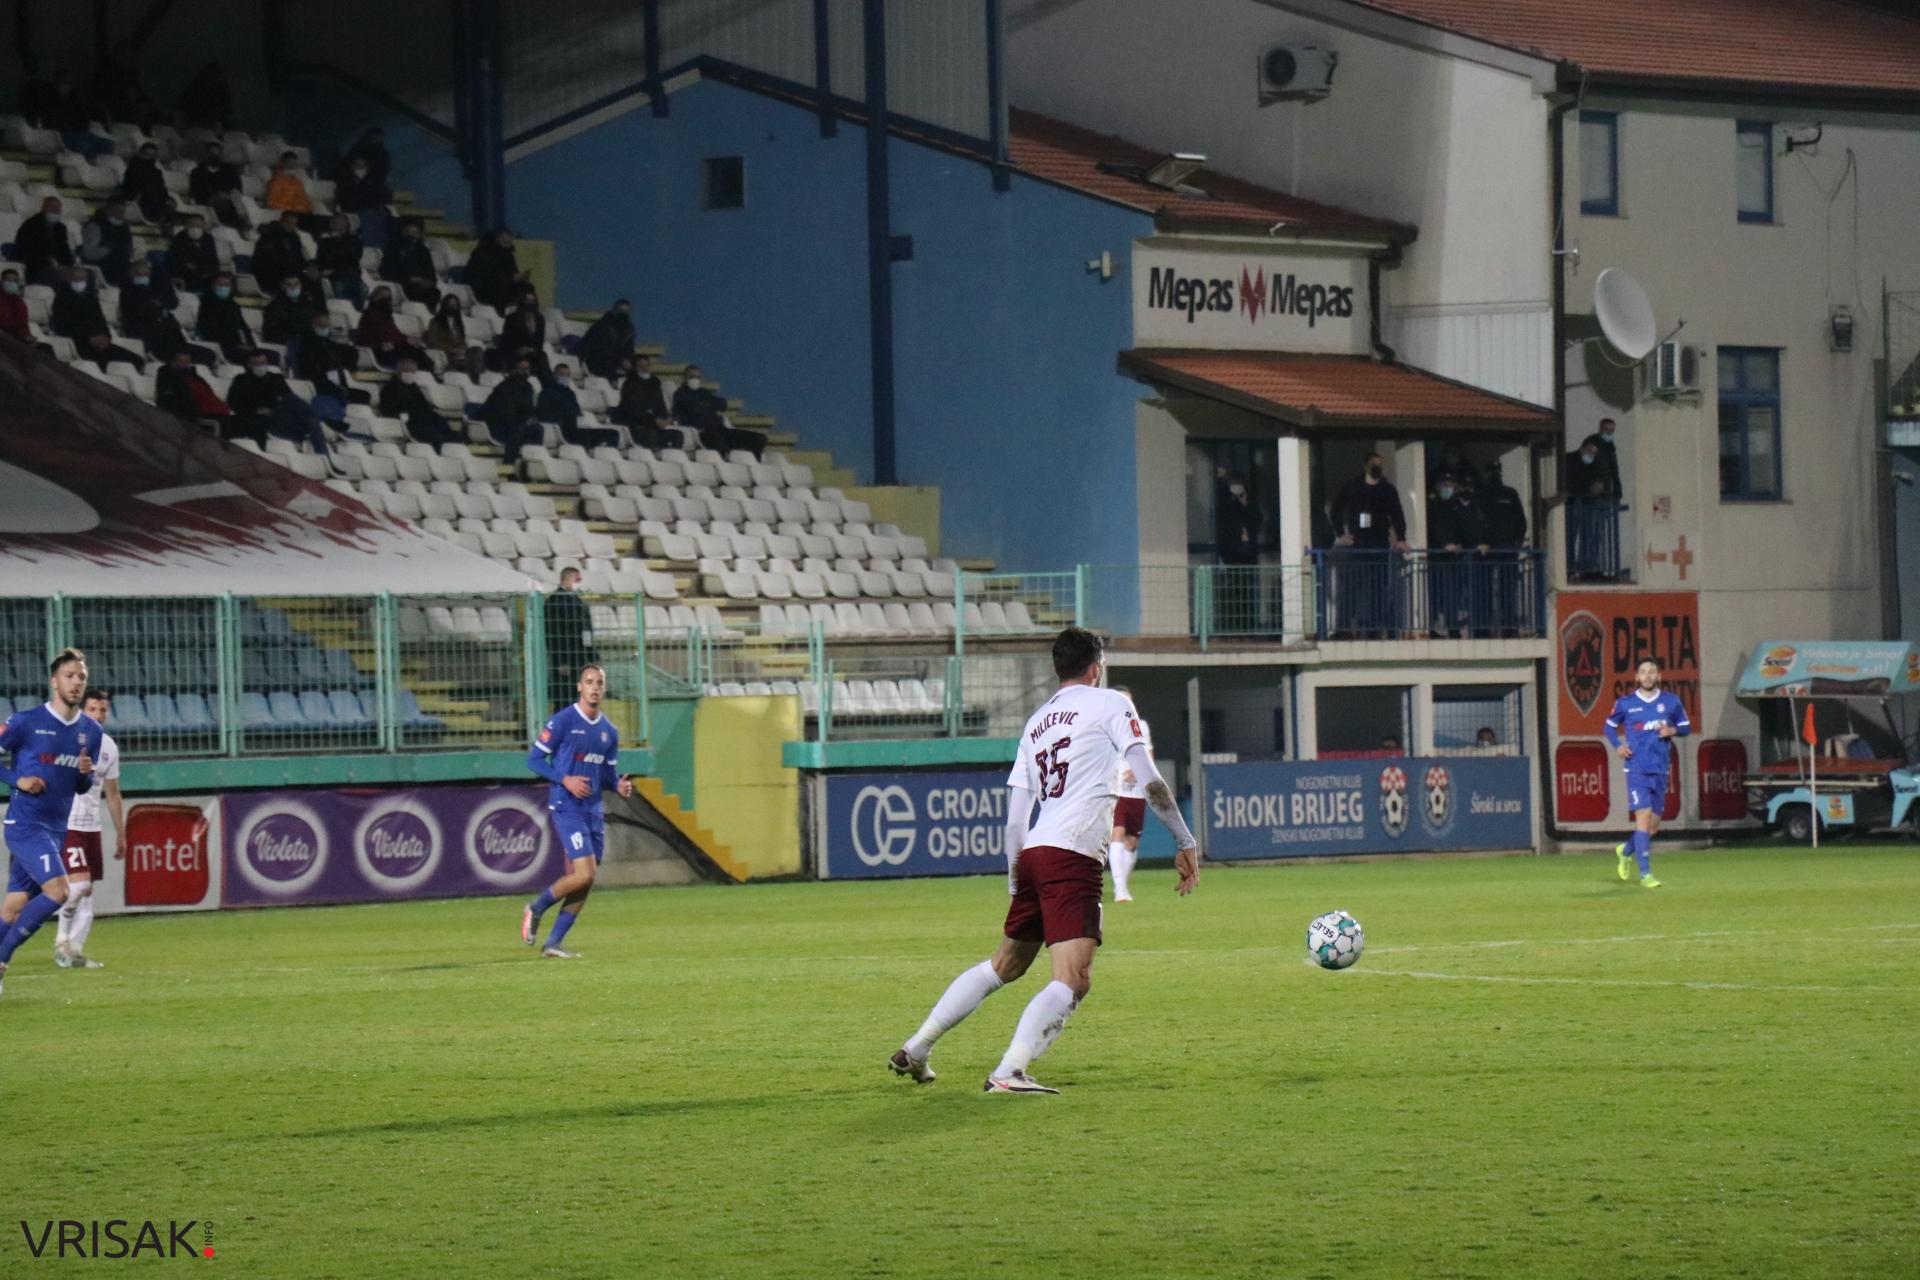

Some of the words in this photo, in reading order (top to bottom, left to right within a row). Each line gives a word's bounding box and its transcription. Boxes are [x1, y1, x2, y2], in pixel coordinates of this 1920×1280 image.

[1148, 267, 1233, 323] Mepas
[1270, 273, 1354, 328] Mepas
[1613, 616, 1698, 673] DELTA
[1035, 736, 1072, 801] 15
[1561, 764, 1604, 796] m:tel
[926, 788, 1013, 820] CROATI
[1213, 789, 1285, 828] ŠIROKI
[1291, 791, 1364, 825] BRIJEG
[133, 838, 200, 873] m:tel
[254, 829, 311, 862] Violeta
[371, 827, 424, 859] Violeta
[482, 824, 535, 856] Violeta
[928, 825, 1007, 858] OSIGU
[66, 846, 88, 868] 21
[1311, 921, 1335, 939] SELEC
